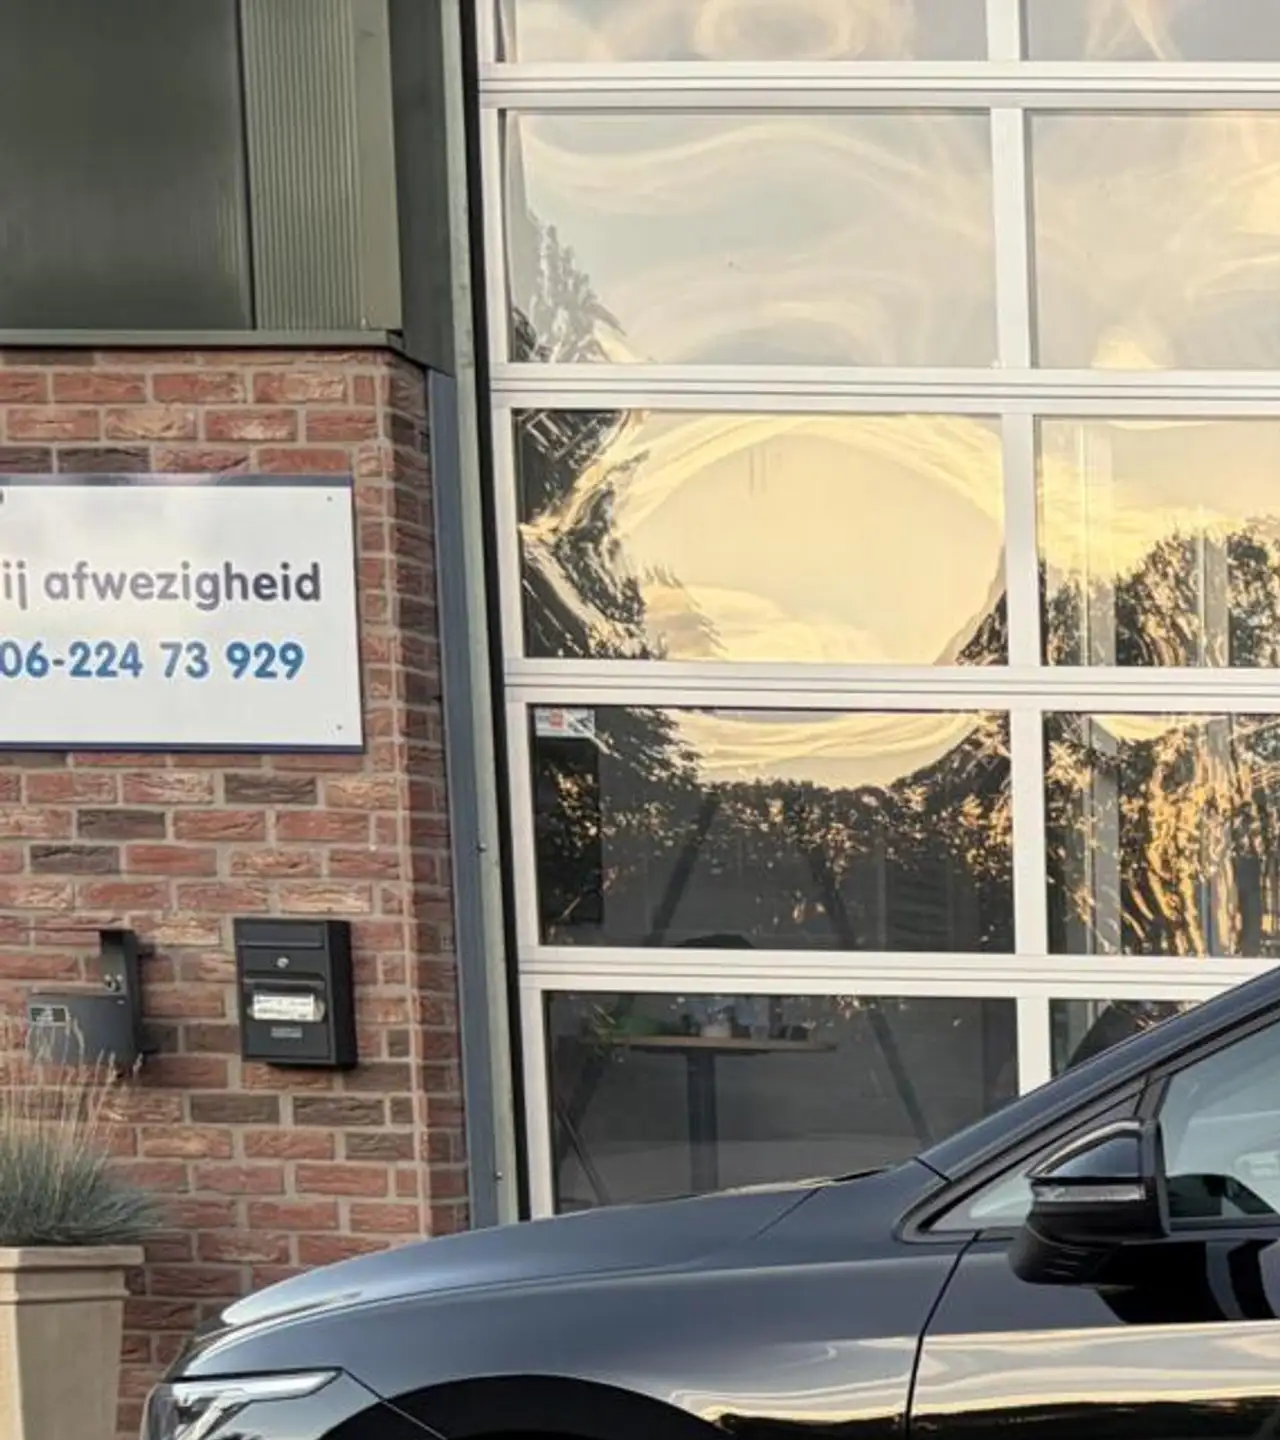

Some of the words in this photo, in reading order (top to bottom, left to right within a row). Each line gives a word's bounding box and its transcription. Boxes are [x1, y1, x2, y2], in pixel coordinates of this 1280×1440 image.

[3, 560, 28, 611] ij
[44, 561, 322, 612] afwezigheid
[0, 640, 143, 679] 06-224
[160, 641, 209, 679] 73
[226, 642, 305, 680] 929
